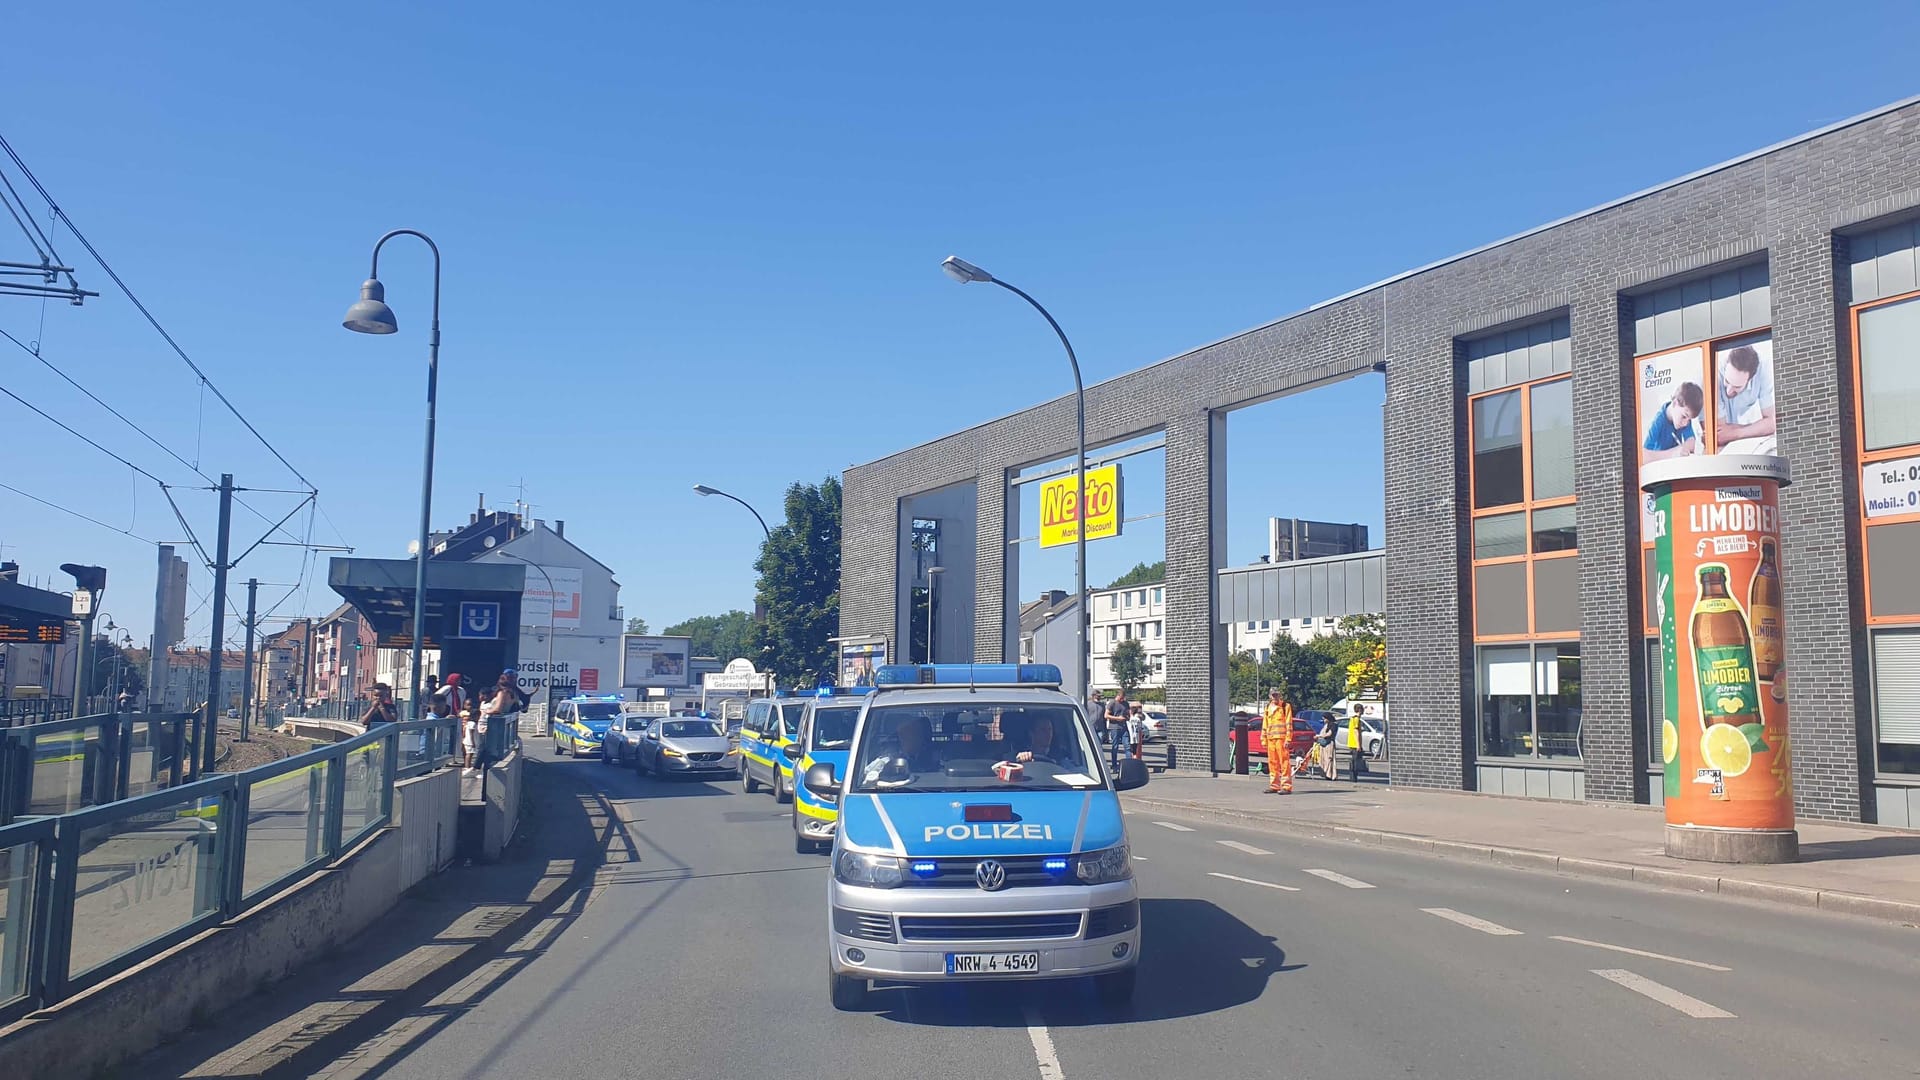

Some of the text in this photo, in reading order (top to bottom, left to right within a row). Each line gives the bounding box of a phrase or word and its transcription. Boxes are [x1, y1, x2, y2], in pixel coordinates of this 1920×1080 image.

[1645, 376, 1672, 388] Centro
[1881, 465, 1920, 484] Tel.: 0
[1718, 487, 1762, 500] Krombacher
[1044, 479, 1114, 527] Neto
[1869, 497, 1904, 511] Mobil.:
[1689, 503, 1779, 533] LIMOBIER
[517, 661, 569, 673] ordstadt
[1703, 667, 1750, 685] LIMOBIER
[518, 676, 578, 688] omobile
[924, 823, 1053, 843] POLIZEI
[955, 954, 1037, 972] NRW 4-4549
